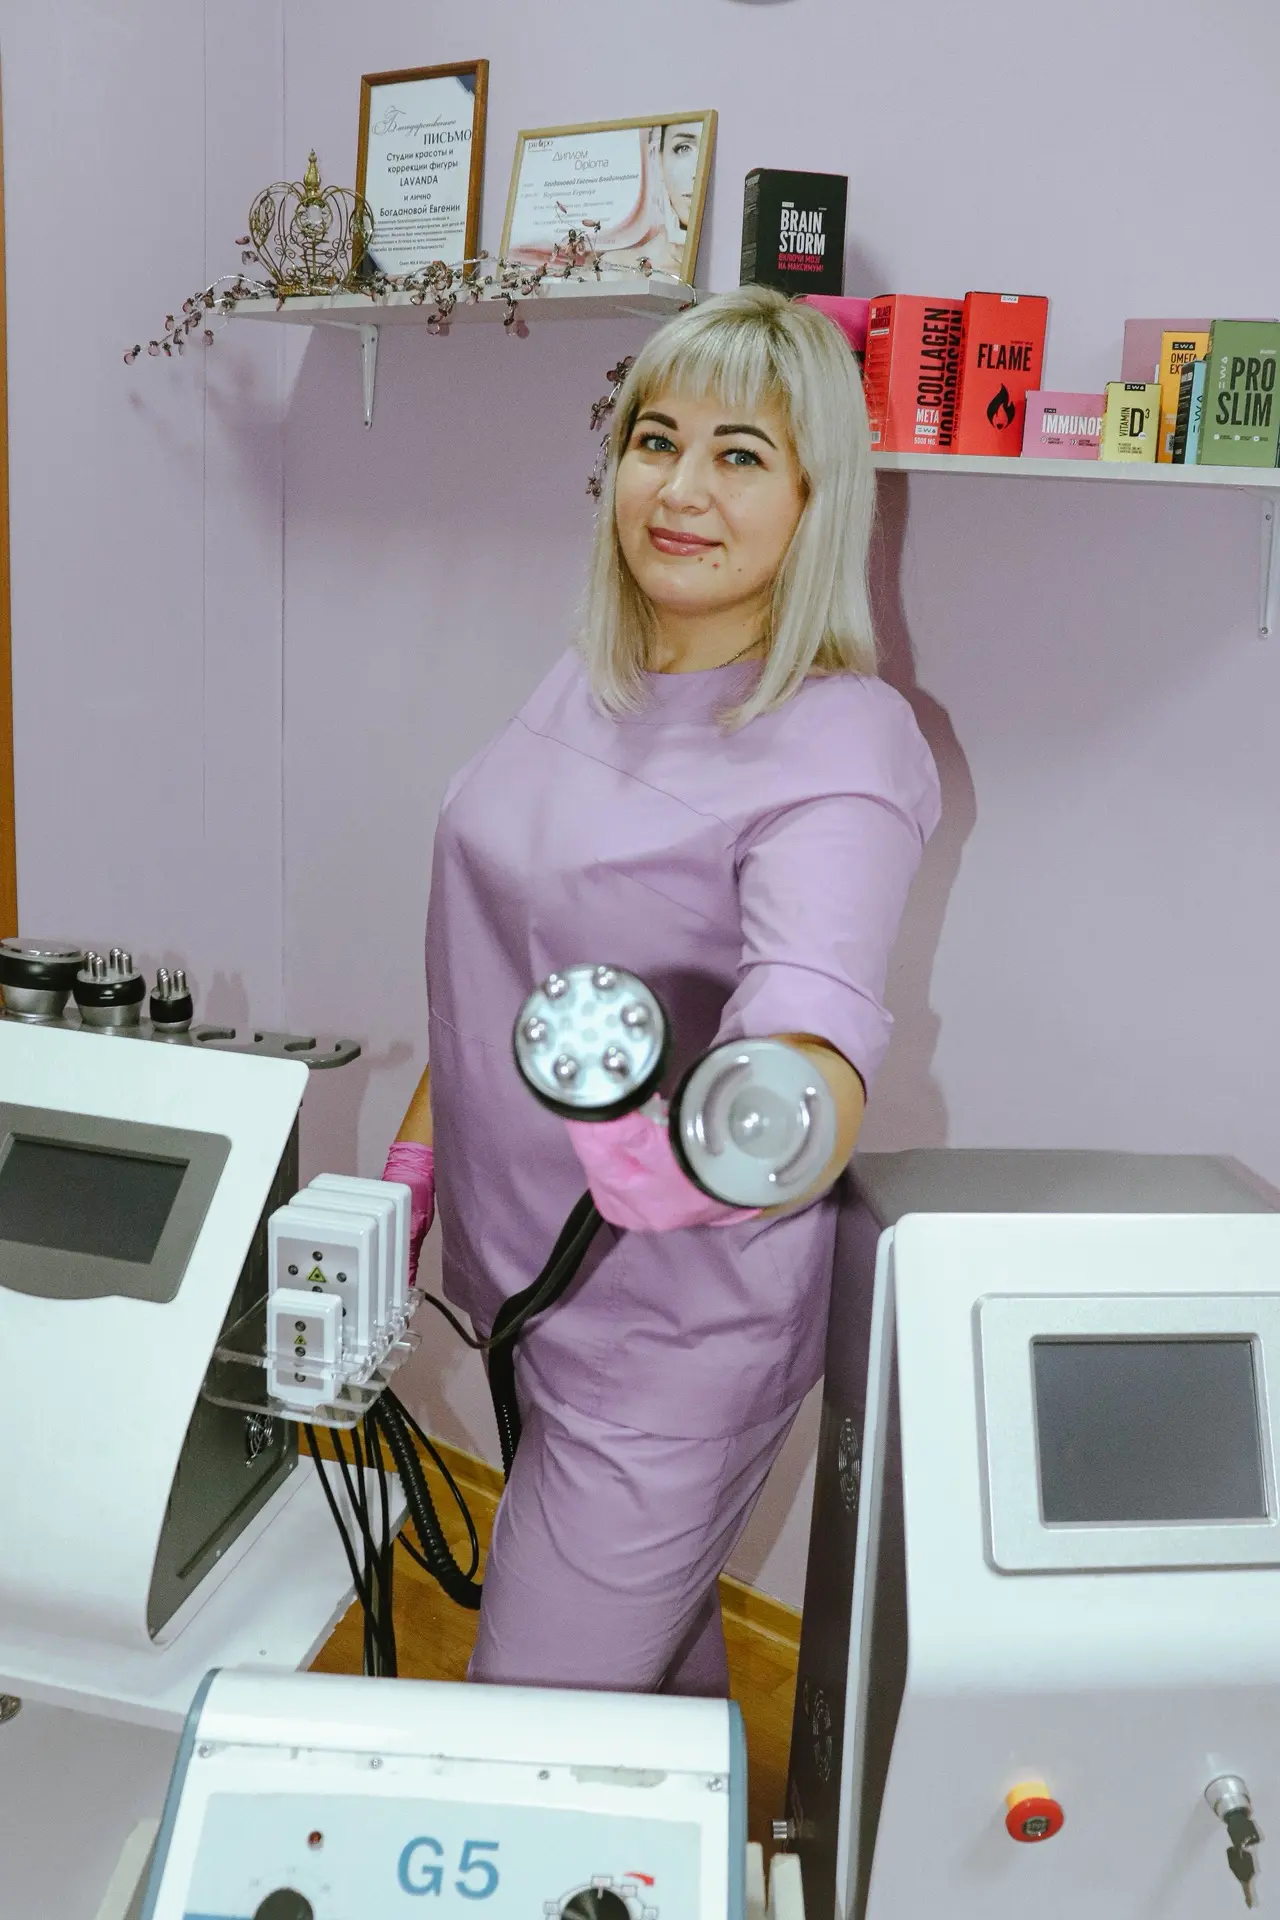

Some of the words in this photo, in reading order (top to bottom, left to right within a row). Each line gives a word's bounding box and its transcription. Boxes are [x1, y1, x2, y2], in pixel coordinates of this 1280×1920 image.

[423, 129, 472, 145] ПИСЬМО
[386, 152, 413, 162] Студии
[415, 149, 447, 159] красоты
[387, 164, 427, 175] коррекции
[429, 160, 458, 172] фигуры
[574, 160, 609, 171] Diploma
[399, 175, 438, 187] LAVANDA
[410, 193, 431, 201] лично
[380, 204, 427, 217] Богдановой
[429, 204, 460, 214] Евгении
[780, 209, 822, 233] BRAIN
[779, 231, 825, 255] STORM
[778, 262, 787, 270] НА
[917, 308, 950, 407] COLLAGEN
[977, 343, 1033, 372] FLAME
[1230, 356, 1277, 392] PRO
[916, 408, 939, 423] META
[1216, 391, 1273, 427] SLIM
[1119, 407, 1130, 437] VITAMIN
[397, 1836, 499, 1901] G5
